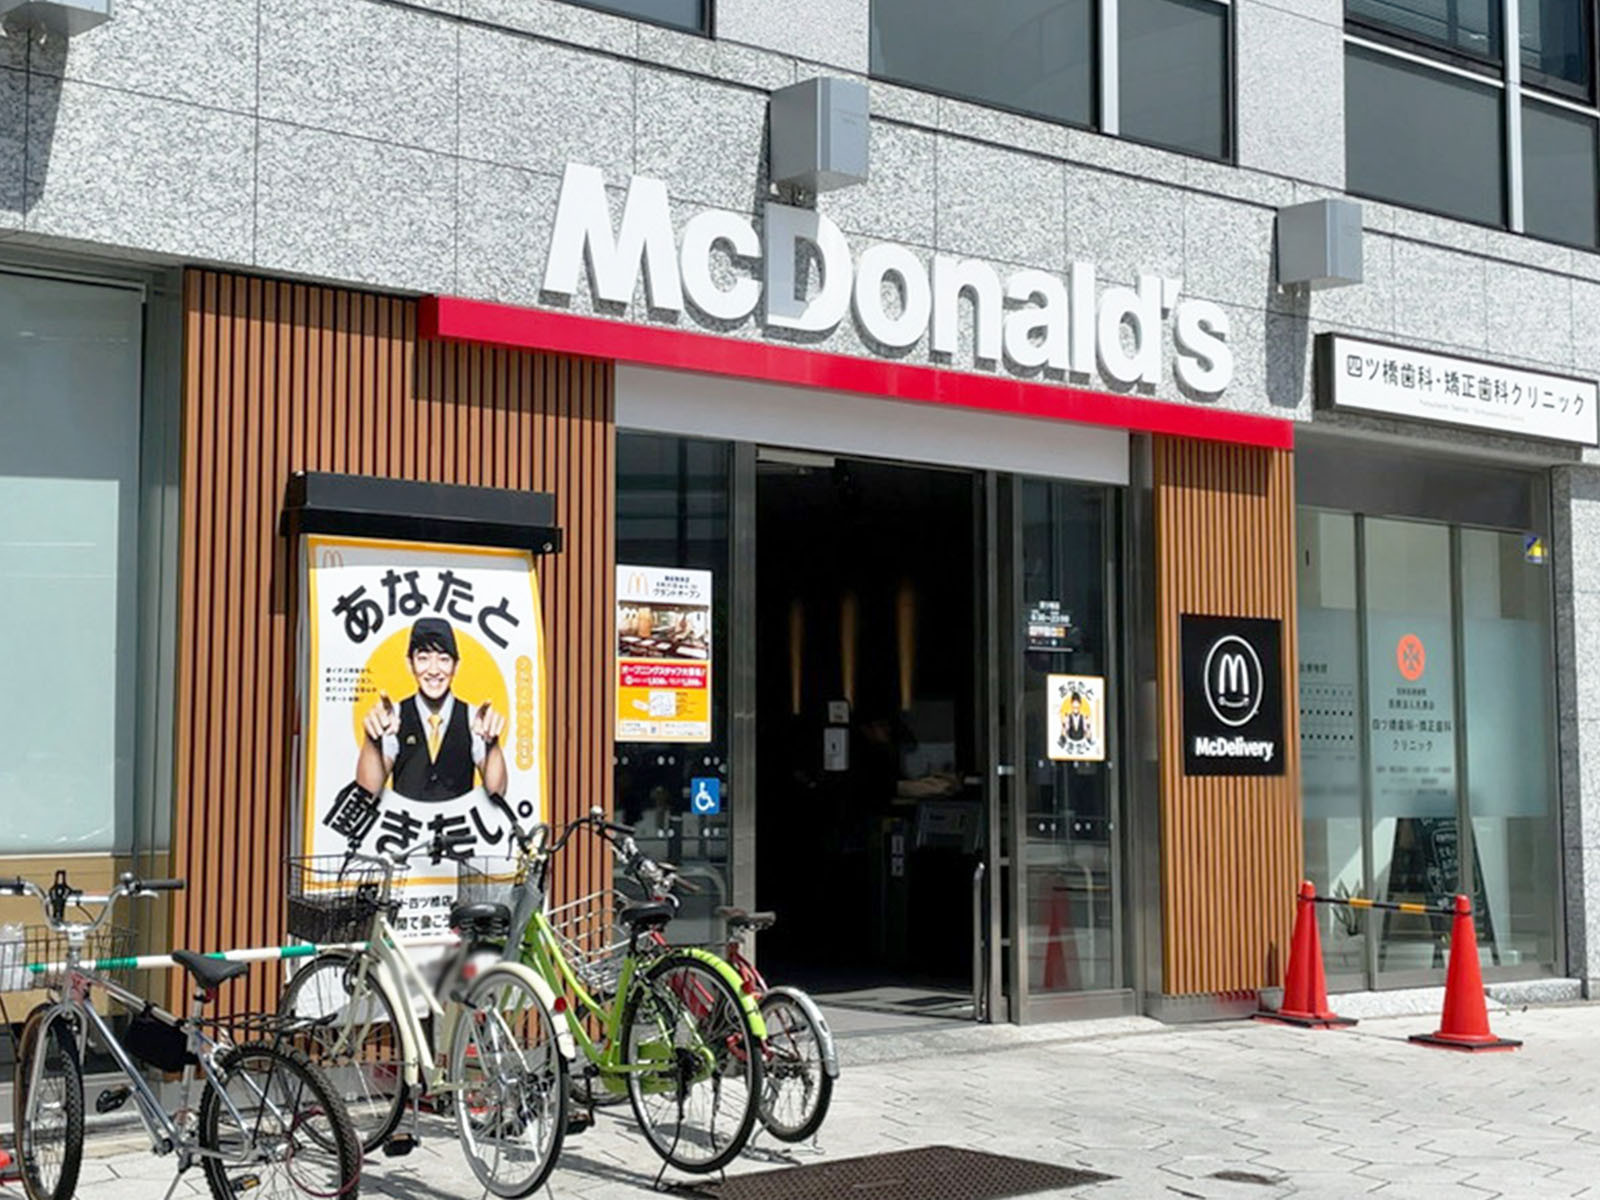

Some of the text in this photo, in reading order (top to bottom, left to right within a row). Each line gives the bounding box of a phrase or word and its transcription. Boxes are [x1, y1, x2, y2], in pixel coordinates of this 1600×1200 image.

[540, 162, 1233, 400] McDonald's
[1346, 354, 1585, 416] 四ツ橋歯科・矯正歯科クリニック
[332, 569, 520, 649] あなたと
[1195, 736, 1274, 762] McDelivery
[1392, 738, 1433, 752] クリニック
